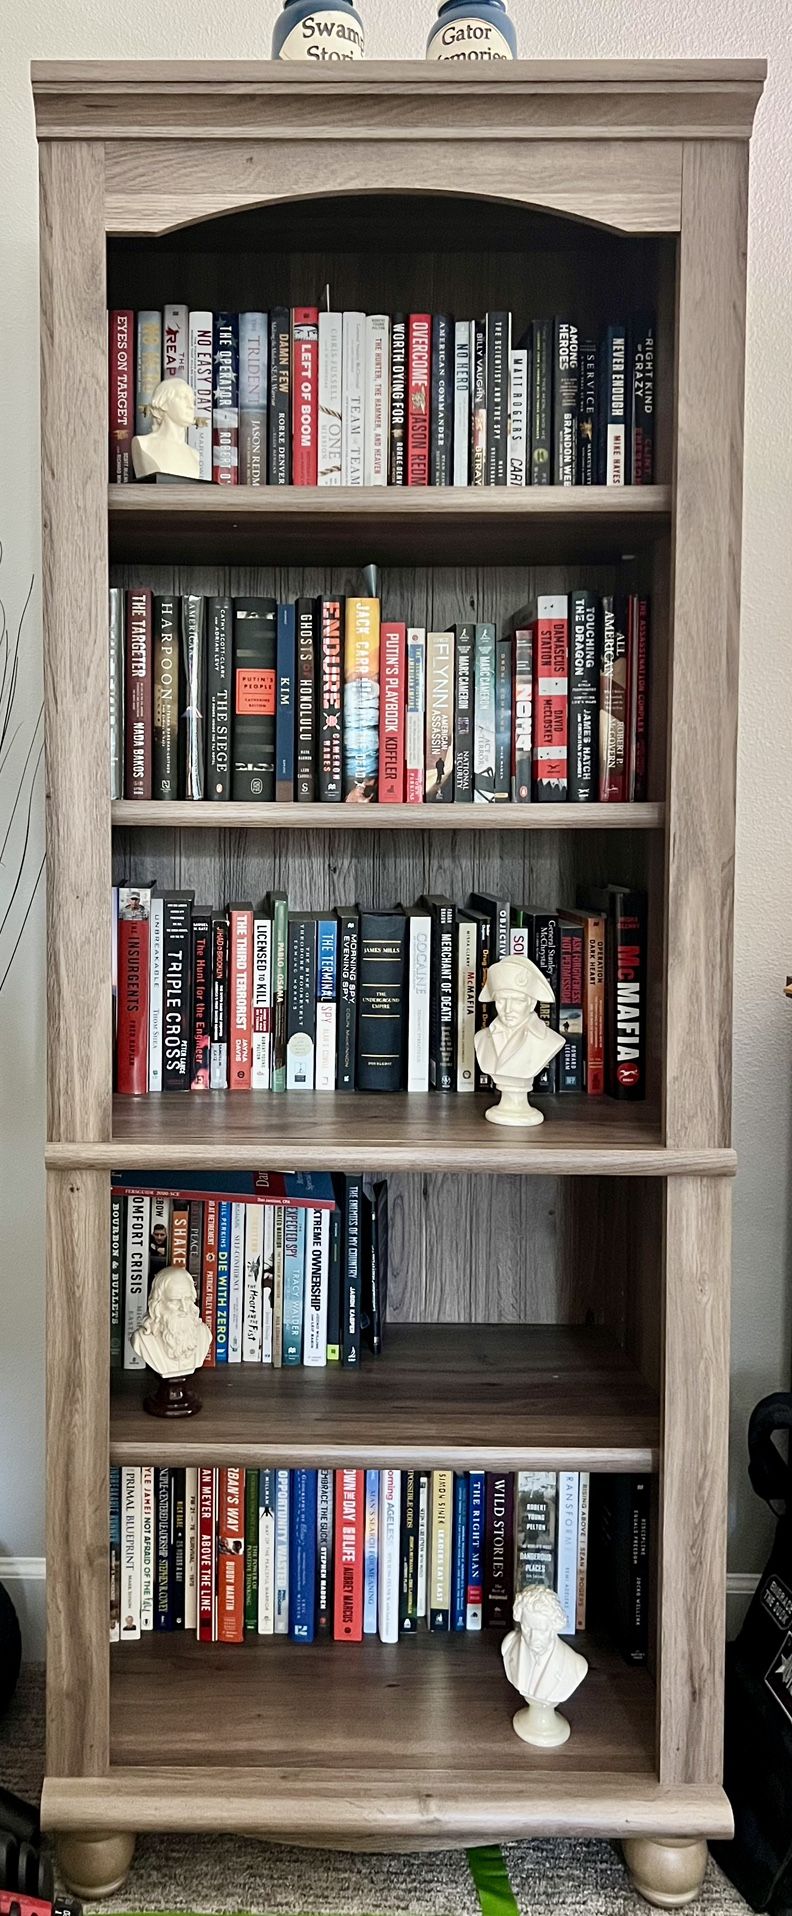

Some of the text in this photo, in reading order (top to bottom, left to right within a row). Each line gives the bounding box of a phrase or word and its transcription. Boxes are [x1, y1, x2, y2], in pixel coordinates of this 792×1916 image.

[442, 25, 491, 45] Gator
[118, 316, 127, 425] EYES ON TARGET
[198, 330, 212, 413] NO EASY DAY
[219, 326, 232, 406] THE OPERATOR
[279, 334, 289, 393] DAMN FEW
[301, 344, 311, 379] LEFT
[392, 324, 405, 424] WORTH DYING FOR
[412, 322, 428, 388] OVERCOME
[456, 343, 468, 391] NO HERO
[559, 324, 569, 371] HEROES
[570, 325, 578, 369] AMONG
[301, 382, 311, 402] OF
[512, 358, 522, 442] MATT ROGERS
[586, 354, 594, 414] SERVICE
[612, 338, 624, 416] NEVER ENOUGH
[634, 353, 644, 397] CRAZY
[645, 338, 654, 414] RIGHT KIND
[220, 432, 232, 468] ROBERT
[301, 405, 311, 447] BOOM
[328, 424, 341, 460] ONE
[613, 435, 621, 484] MIKE HAYES
[131, 595, 146, 616] THE
[575, 599, 584, 622] THE
[131, 620, 146, 678] TARGETER
[161, 602, 173, 701] HARPOON
[322, 602, 340, 710] ENDURE
[356, 602, 370, 673] JACK CARR
[541, 630, 552, 666] STATION
[554, 624, 565, 673] DAMASCUS
[575, 626, 584, 676] DRAGON
[586, 607, 595, 668] TOUCHING
[604, 610, 614, 677] AMERICAN
[616, 632, 625, 656] ALL
[281, 677, 290, 706] KIM
[386, 633, 399, 733] PUTIN'S PLAYBOOK
[432, 644, 450, 709] FLYNN
[458, 656, 469, 710] MARC CAMERON
[133, 722, 144, 747] NADA
[216, 690, 228, 773] THE SIEGE
[432, 710, 441, 755] ASSASSIN
[555, 710, 563, 733] DAVID
[583, 710, 592, 744] JAMES
[133, 749, 144, 778] BAKOS
[385, 736, 398, 780] KOFFLER
[583, 746, 592, 780] HATCH
[127, 936, 140, 1012] INSURGENTS
[166, 950, 182, 1007] TRIPLE
[236, 914, 248, 1031] THE THIRD TERRORIST
[256, 924, 268, 1005] LICENSED TO KILL
[320, 934, 334, 1002] THE TERMINAL
[416, 933, 427, 995] COCAINE
[440, 934, 452, 1022] MERCHANT OF DEATH
[322, 1006, 333, 1024] SPY
[466, 972, 474, 1015] McMAFIA
[617, 946, 640, 1061] McMAFIA
[164, 1012, 181, 1071] CROSS
[348, 1186, 358, 1197] THE
[348, 1199, 358, 1225] ENEMIES
[190, 1228, 199, 1255] PEACE
[348, 1236, 358, 1244] MY
[348, 1247, 358, 1278] COUNTRY
[218, 1252, 228, 1343] DIE WITH ZERO
[126, 1472, 136, 1571] PRIMAL BLUEPRINT
[344, 1470, 356, 1522] OWN DAY
[438, 1473, 446, 1524] SIMON SINEK
[278, 1470, 288, 1587] OPPORTUNITY WASTED
[342, 1543, 356, 1562] LIFE
[472, 1481, 480, 1578] THE RIGHT MAN
[493, 1479, 505, 1578] WILD STORIES
[201, 1534, 211, 1611] ABOVE THE LINE
[226, 1561, 235, 1611] BUDDY MARTIN
[436, 1529, 444, 1601] LEADERS EAT LAST
[343, 1567, 354, 1623] AUBREY MARCUS
